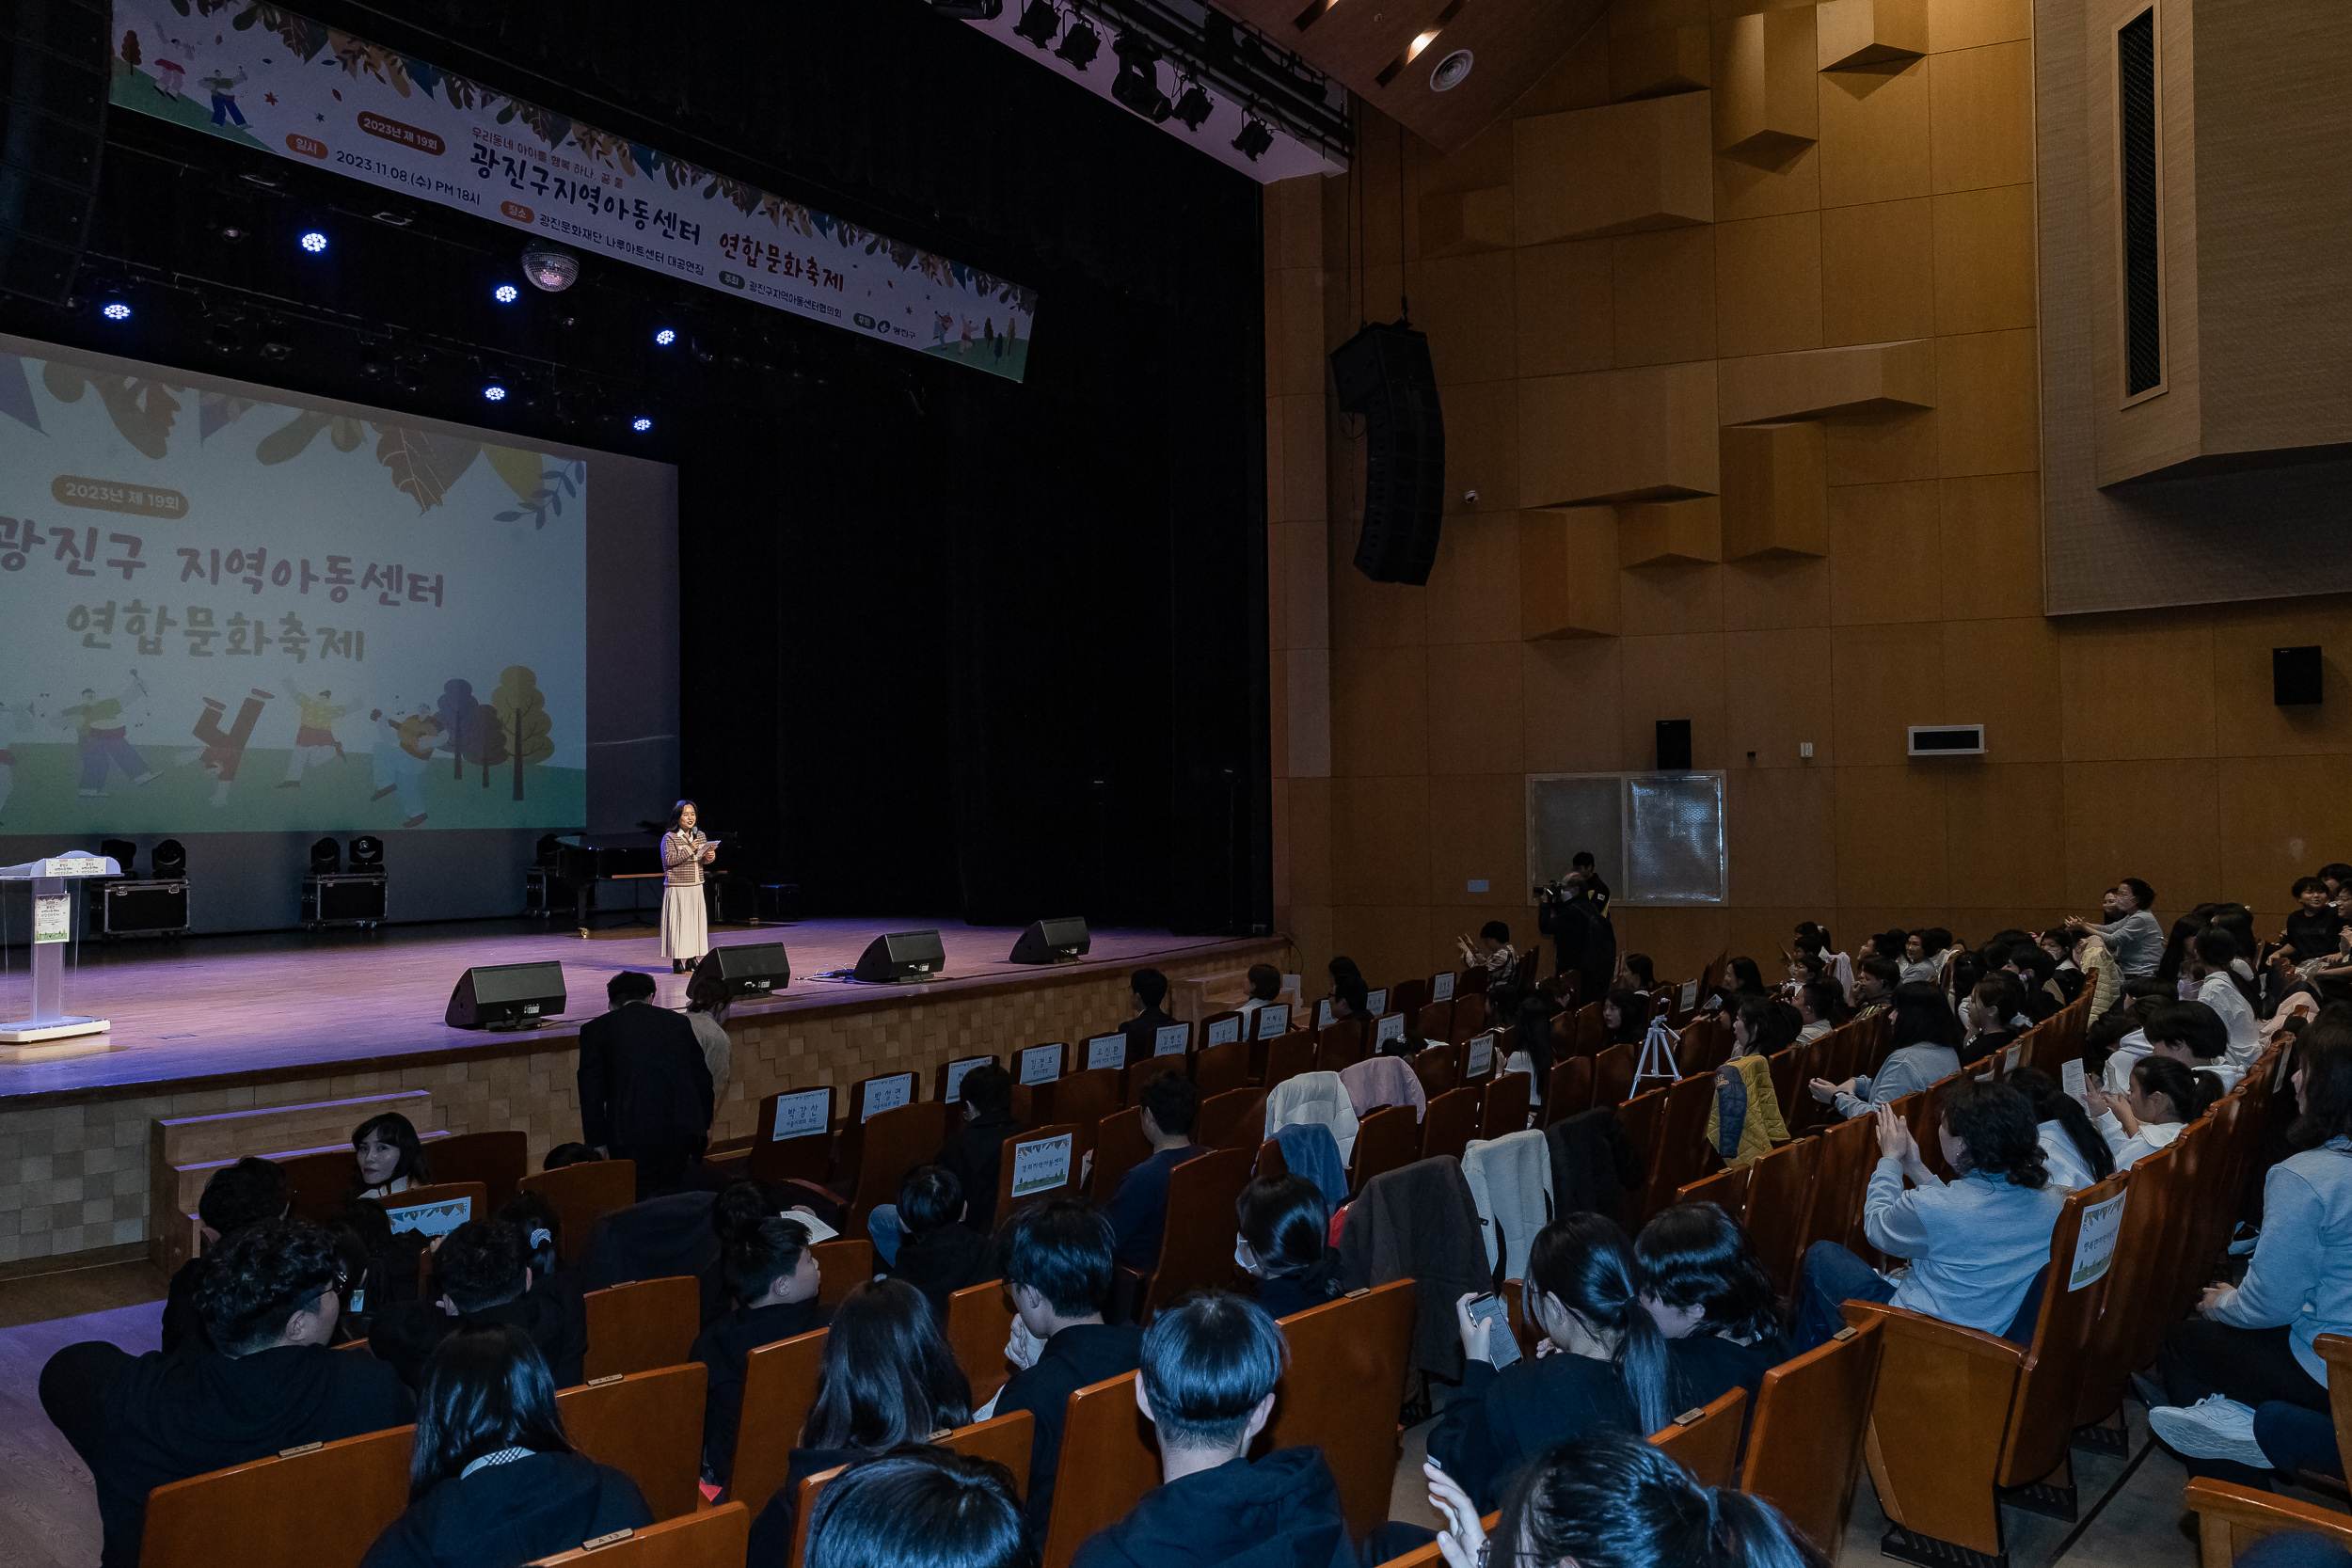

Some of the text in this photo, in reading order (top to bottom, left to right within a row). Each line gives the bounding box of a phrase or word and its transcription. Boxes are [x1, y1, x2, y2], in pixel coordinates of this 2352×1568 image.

[295, 138, 317, 155] 일시
[363, 118, 437, 150] 2023년 제 19회
[471, 127, 514, 150] 우리동네
[517, 142, 548, 163] 아이들
[550, 153, 570, 172] 행복
[336, 150, 480, 206] 2023.11.08.(수) PM 18시
[469, 142, 844, 293] 광진구지역아동센터 연합문화축제
[508, 204, 527, 219] 장소
[539, 214, 705, 277] 광진문화재단 나루아트센터 대공연장
[66, 482, 180, 512] 2023년 제 19회
[0, 515, 444, 608] 광진구 지역아동센터
[66, 598, 365, 663] 연합문화축제
[787, 1103, 818, 1119] 박강산
